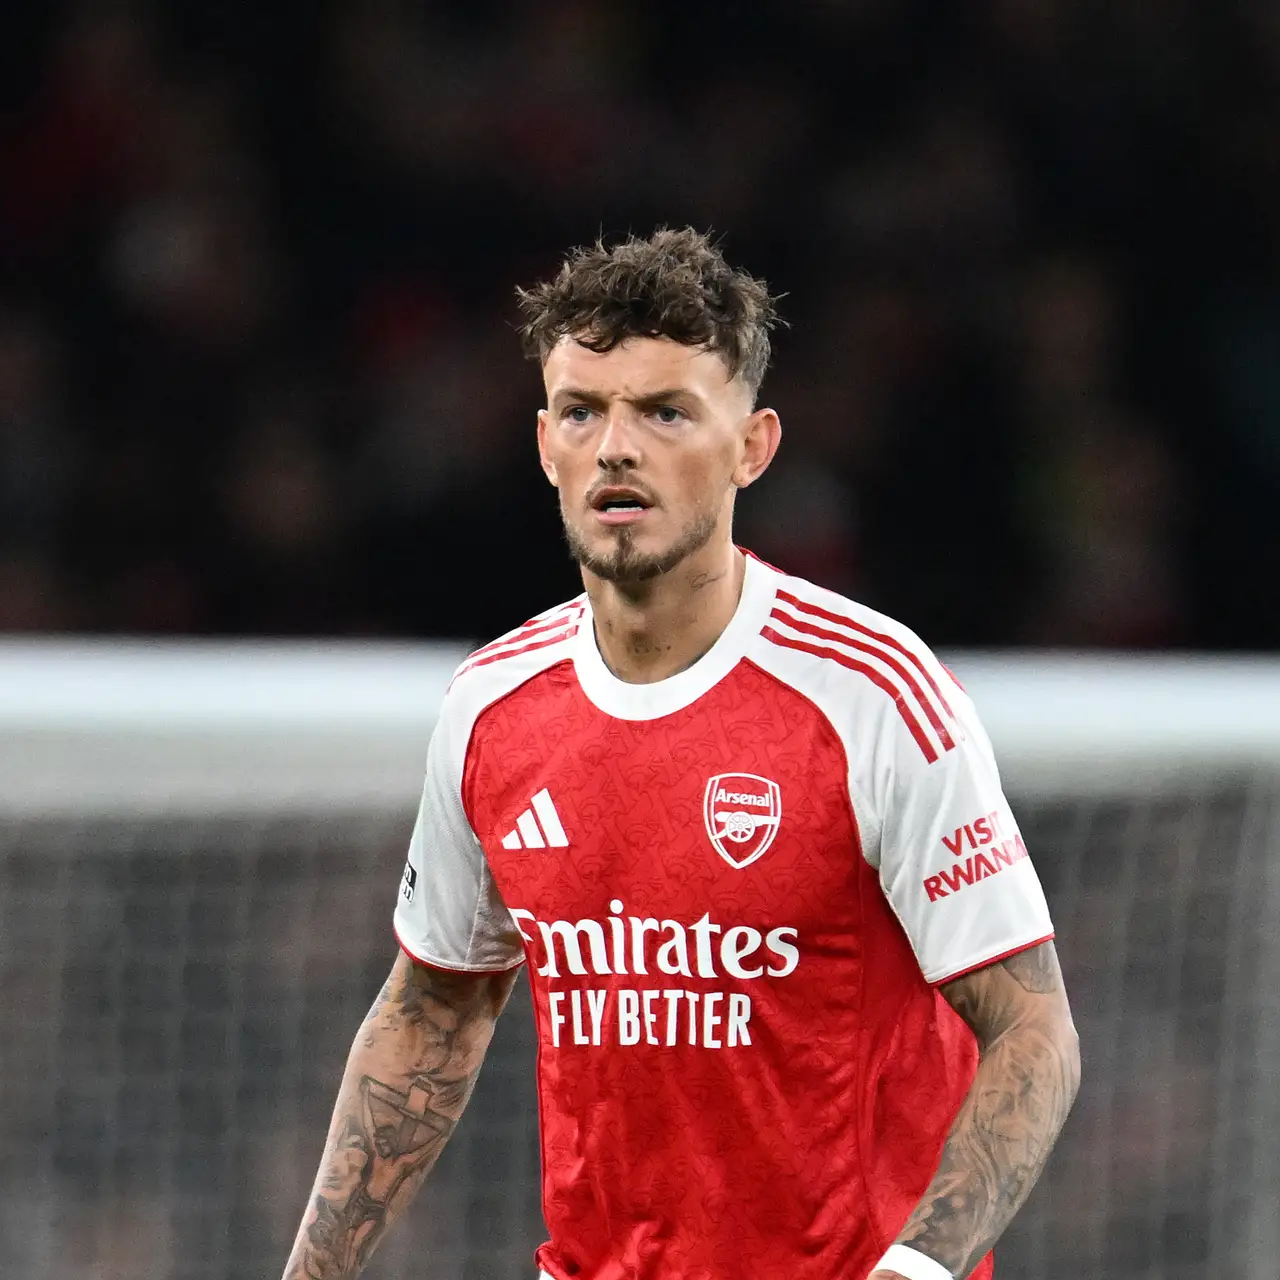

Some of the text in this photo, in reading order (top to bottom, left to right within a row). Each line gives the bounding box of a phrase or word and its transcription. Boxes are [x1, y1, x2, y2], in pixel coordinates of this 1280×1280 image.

[715, 788, 770, 808] Arsenal
[549, 989, 752, 1049] FLY BETTER
